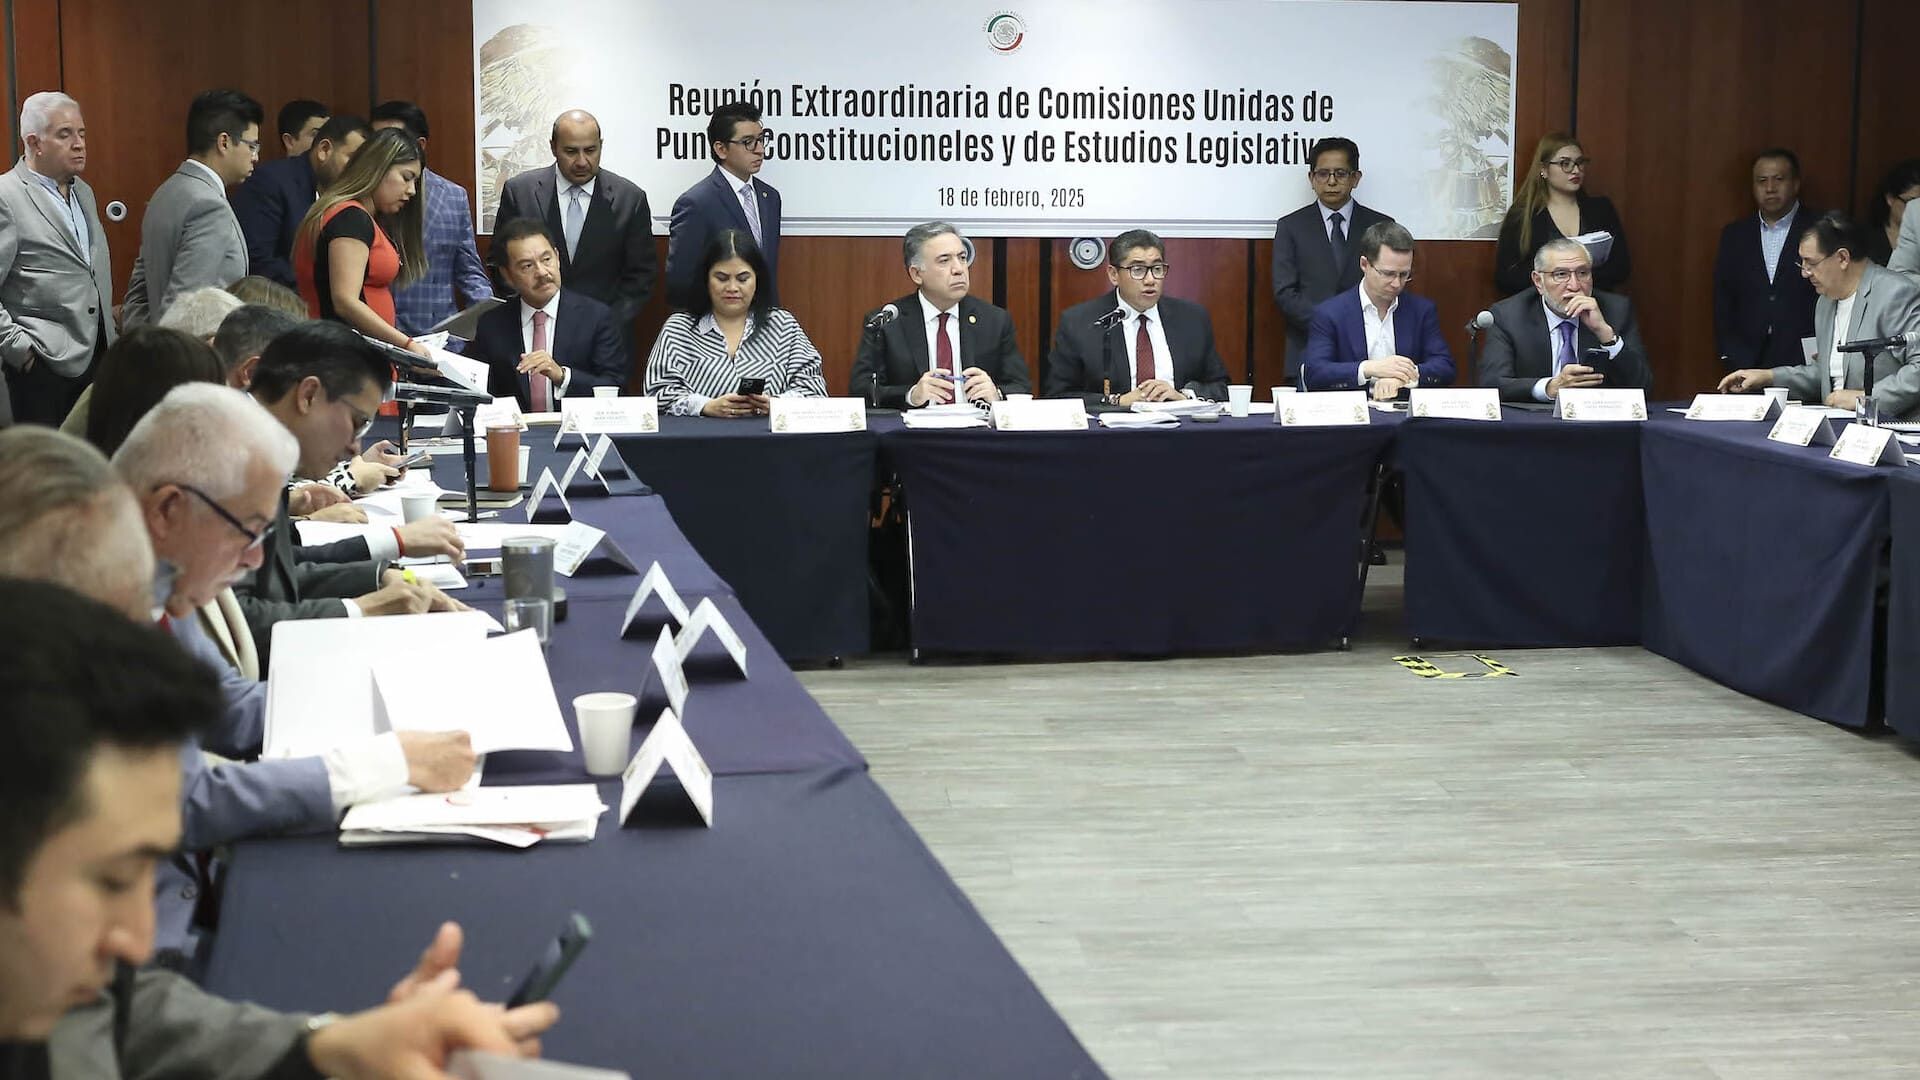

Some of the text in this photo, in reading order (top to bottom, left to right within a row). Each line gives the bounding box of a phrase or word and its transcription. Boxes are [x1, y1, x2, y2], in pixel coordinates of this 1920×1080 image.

[669, 79, 1334, 123] Reunión Extraordinaria de Comisiones Unidas de
[1002, 135, 1016, 167] y
[1024, 130, 1055, 163] de
[1064, 129, 1178, 164] Estudios
[1186, 131, 1315, 168] Legislativ
[938, 187, 1084, 210] 18 de febrero, 2025
